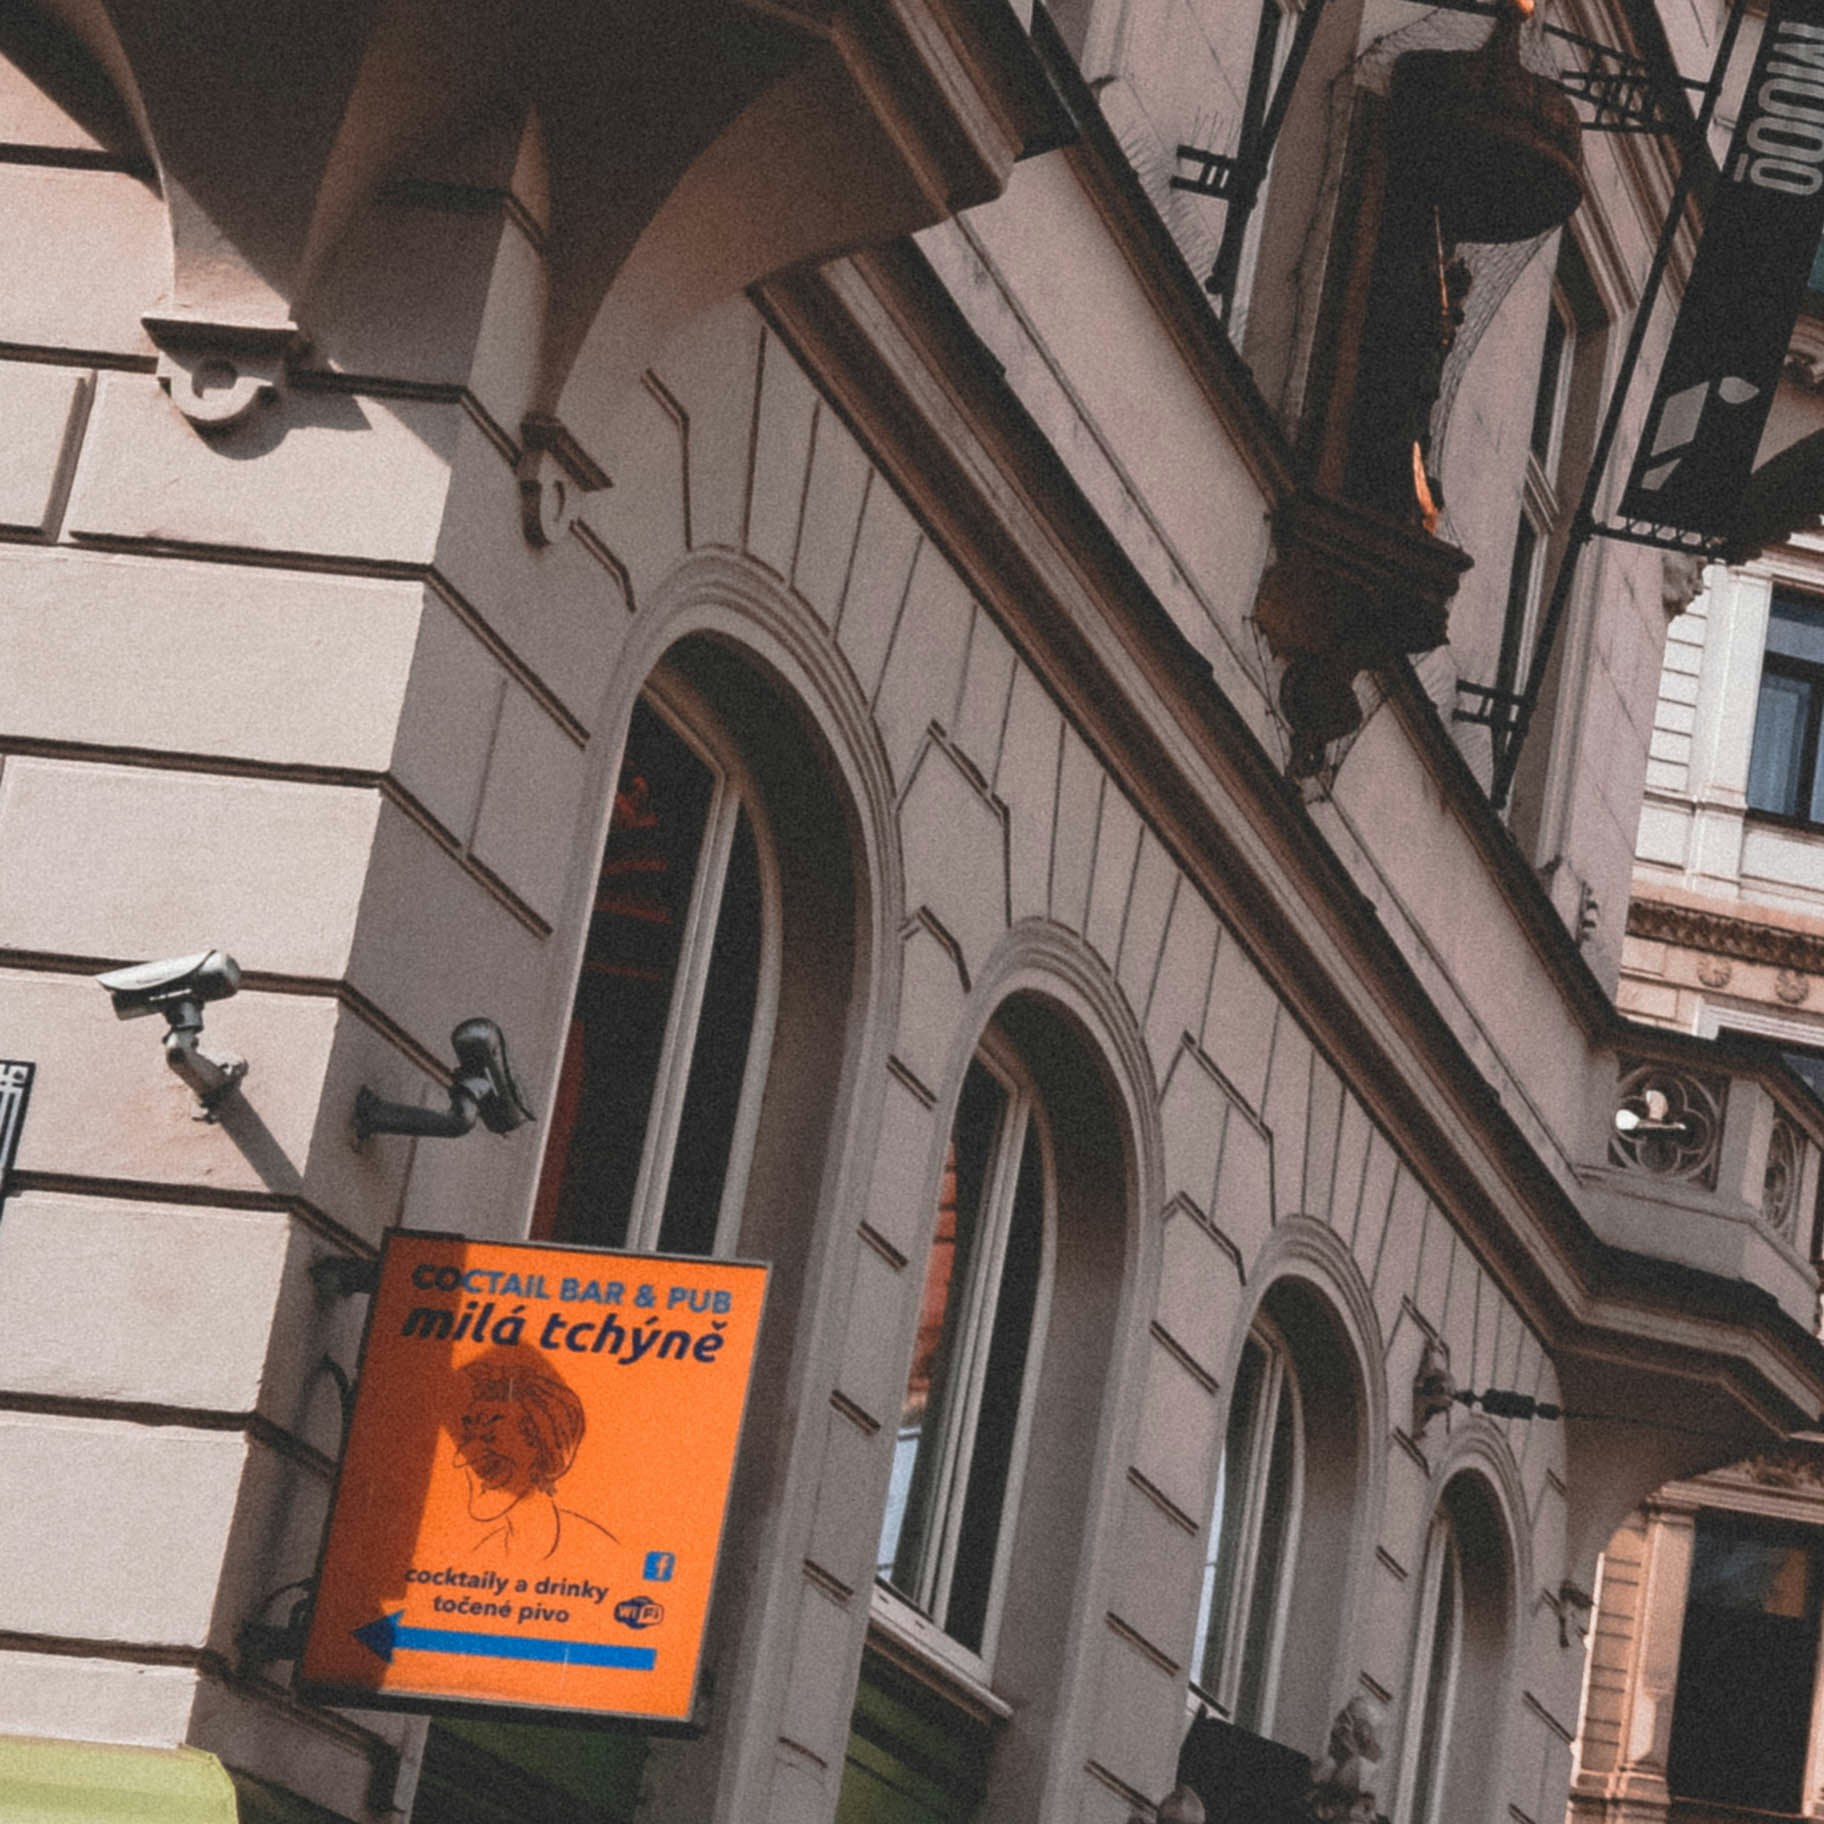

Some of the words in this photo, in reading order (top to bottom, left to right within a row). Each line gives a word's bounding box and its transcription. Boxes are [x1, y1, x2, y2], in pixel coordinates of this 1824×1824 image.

[411, 1263, 550, 1301] COCTAIL
[560, 1277, 625, 1306] BAR
[634, 1284, 657, 1308] &
[667, 1286, 732, 1314] PUB
[401, 1300, 526, 1346] milá
[539, 1312, 728, 1365] tchýně
[404, 1566, 509, 1596] cocktaily
[515, 1579, 528, 1593] a
[534, 1576, 609, 1605] drinky
[433, 1595, 512, 1618] točené
[517, 1601, 570, 1625] pivo
